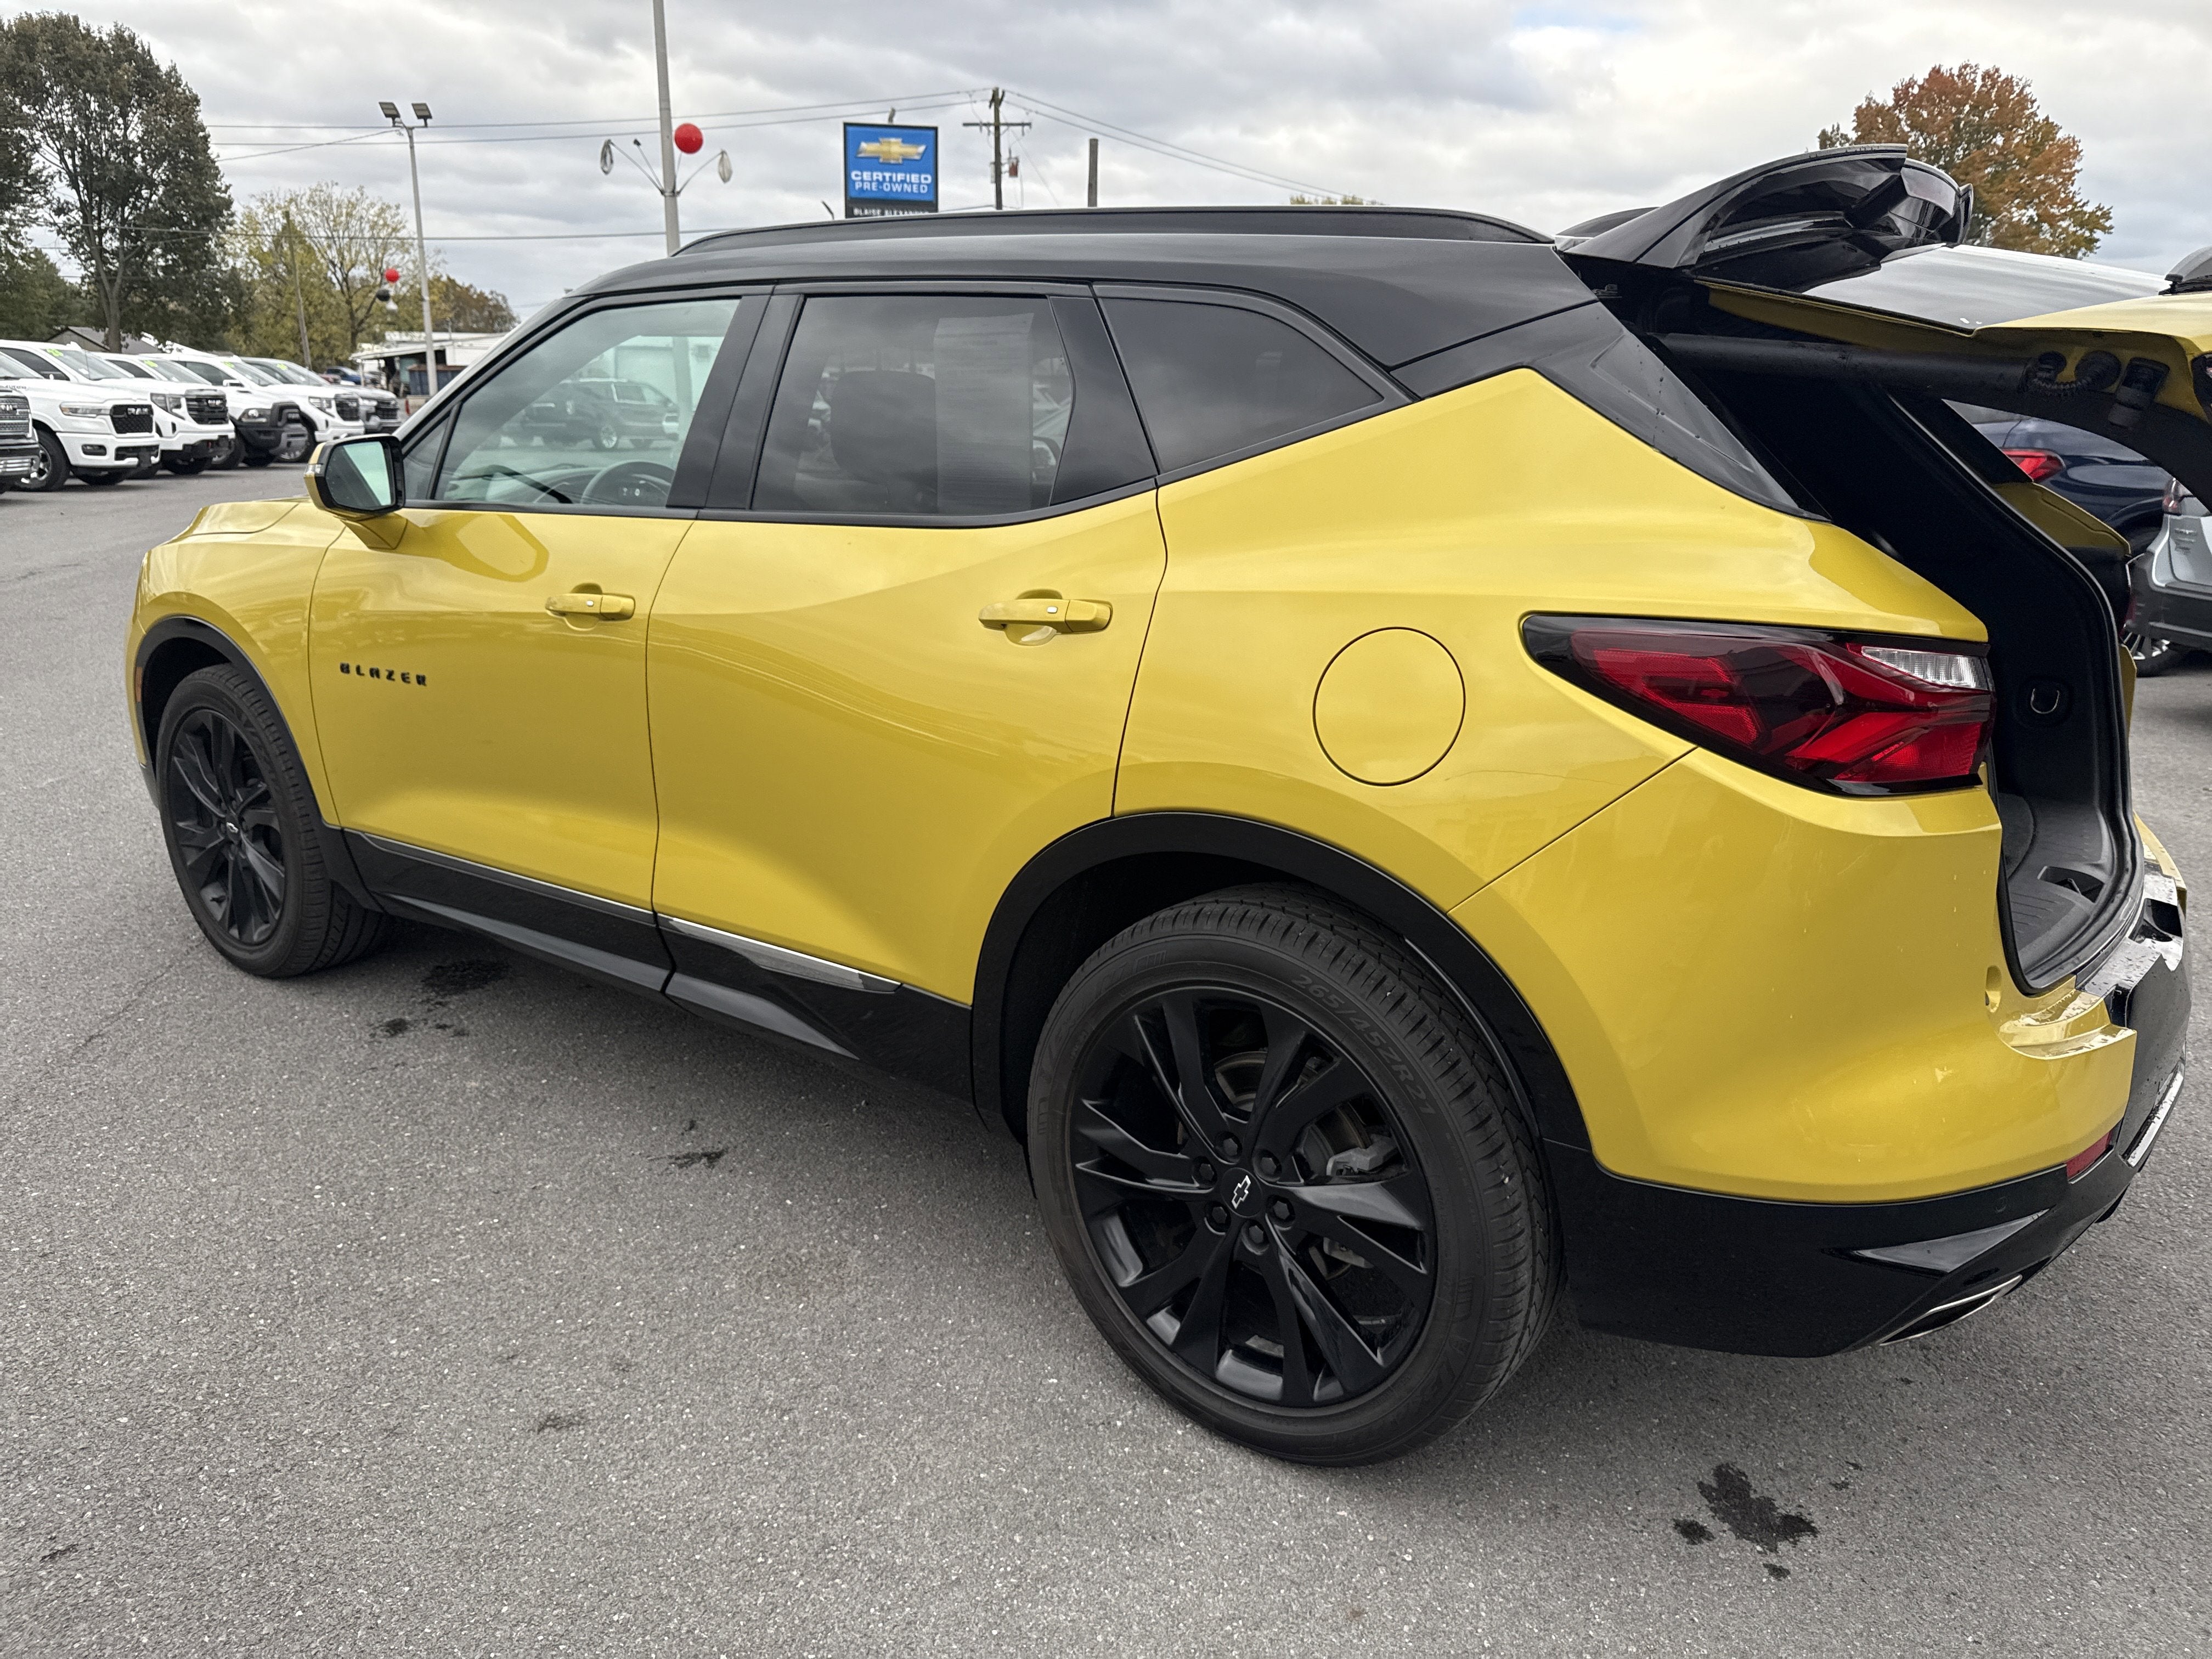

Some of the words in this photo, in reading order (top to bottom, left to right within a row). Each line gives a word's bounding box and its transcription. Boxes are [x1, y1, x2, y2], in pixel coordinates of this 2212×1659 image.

[851, 171, 932, 184] CERTIFIED
[855, 182, 928, 193] PRE-OWNED
[340, 662, 427, 686] BLAZER
[1291, 974, 1436, 1115] 265/45ZR21
